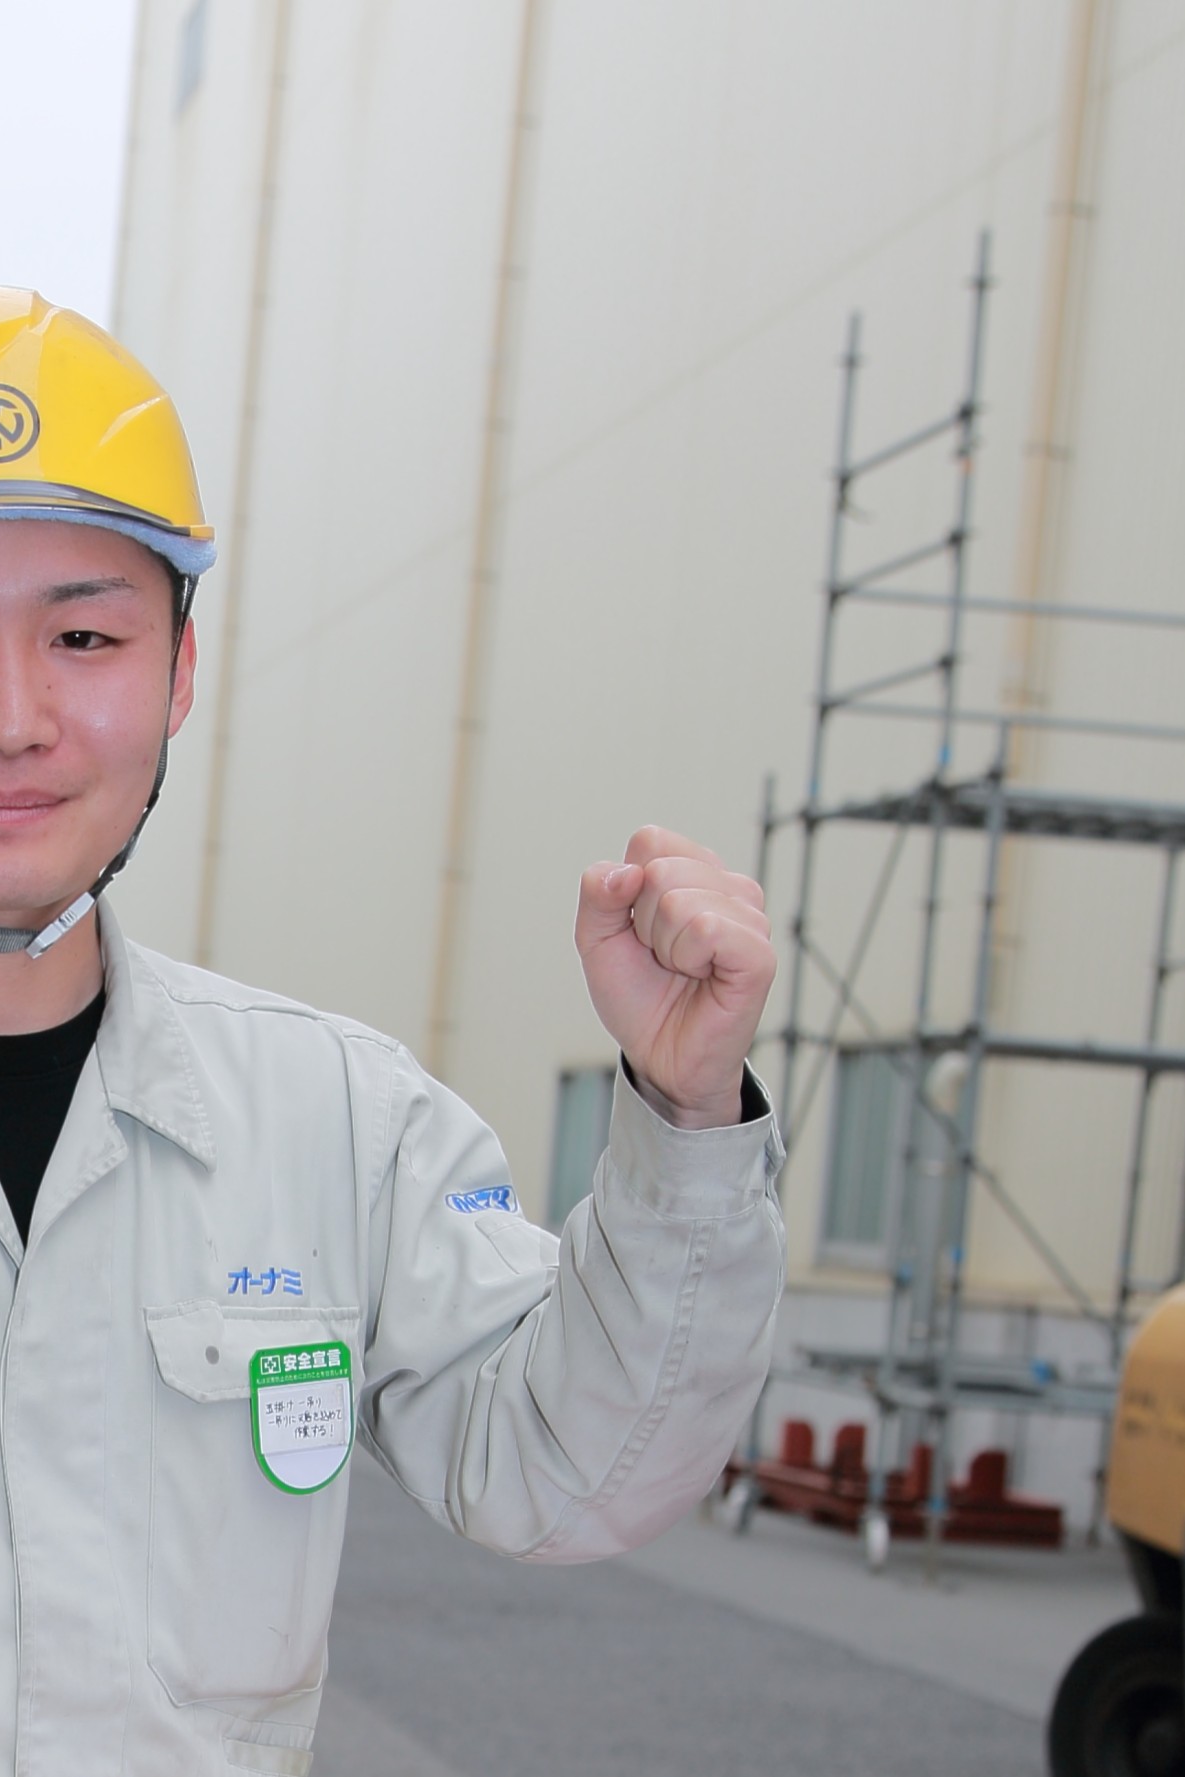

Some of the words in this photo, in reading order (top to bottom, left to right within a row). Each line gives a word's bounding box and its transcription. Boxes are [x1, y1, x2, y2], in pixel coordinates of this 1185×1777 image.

[227, 1266, 303, 1296] オーナミ
[283, 1348, 341, 1372] 安全宣言
